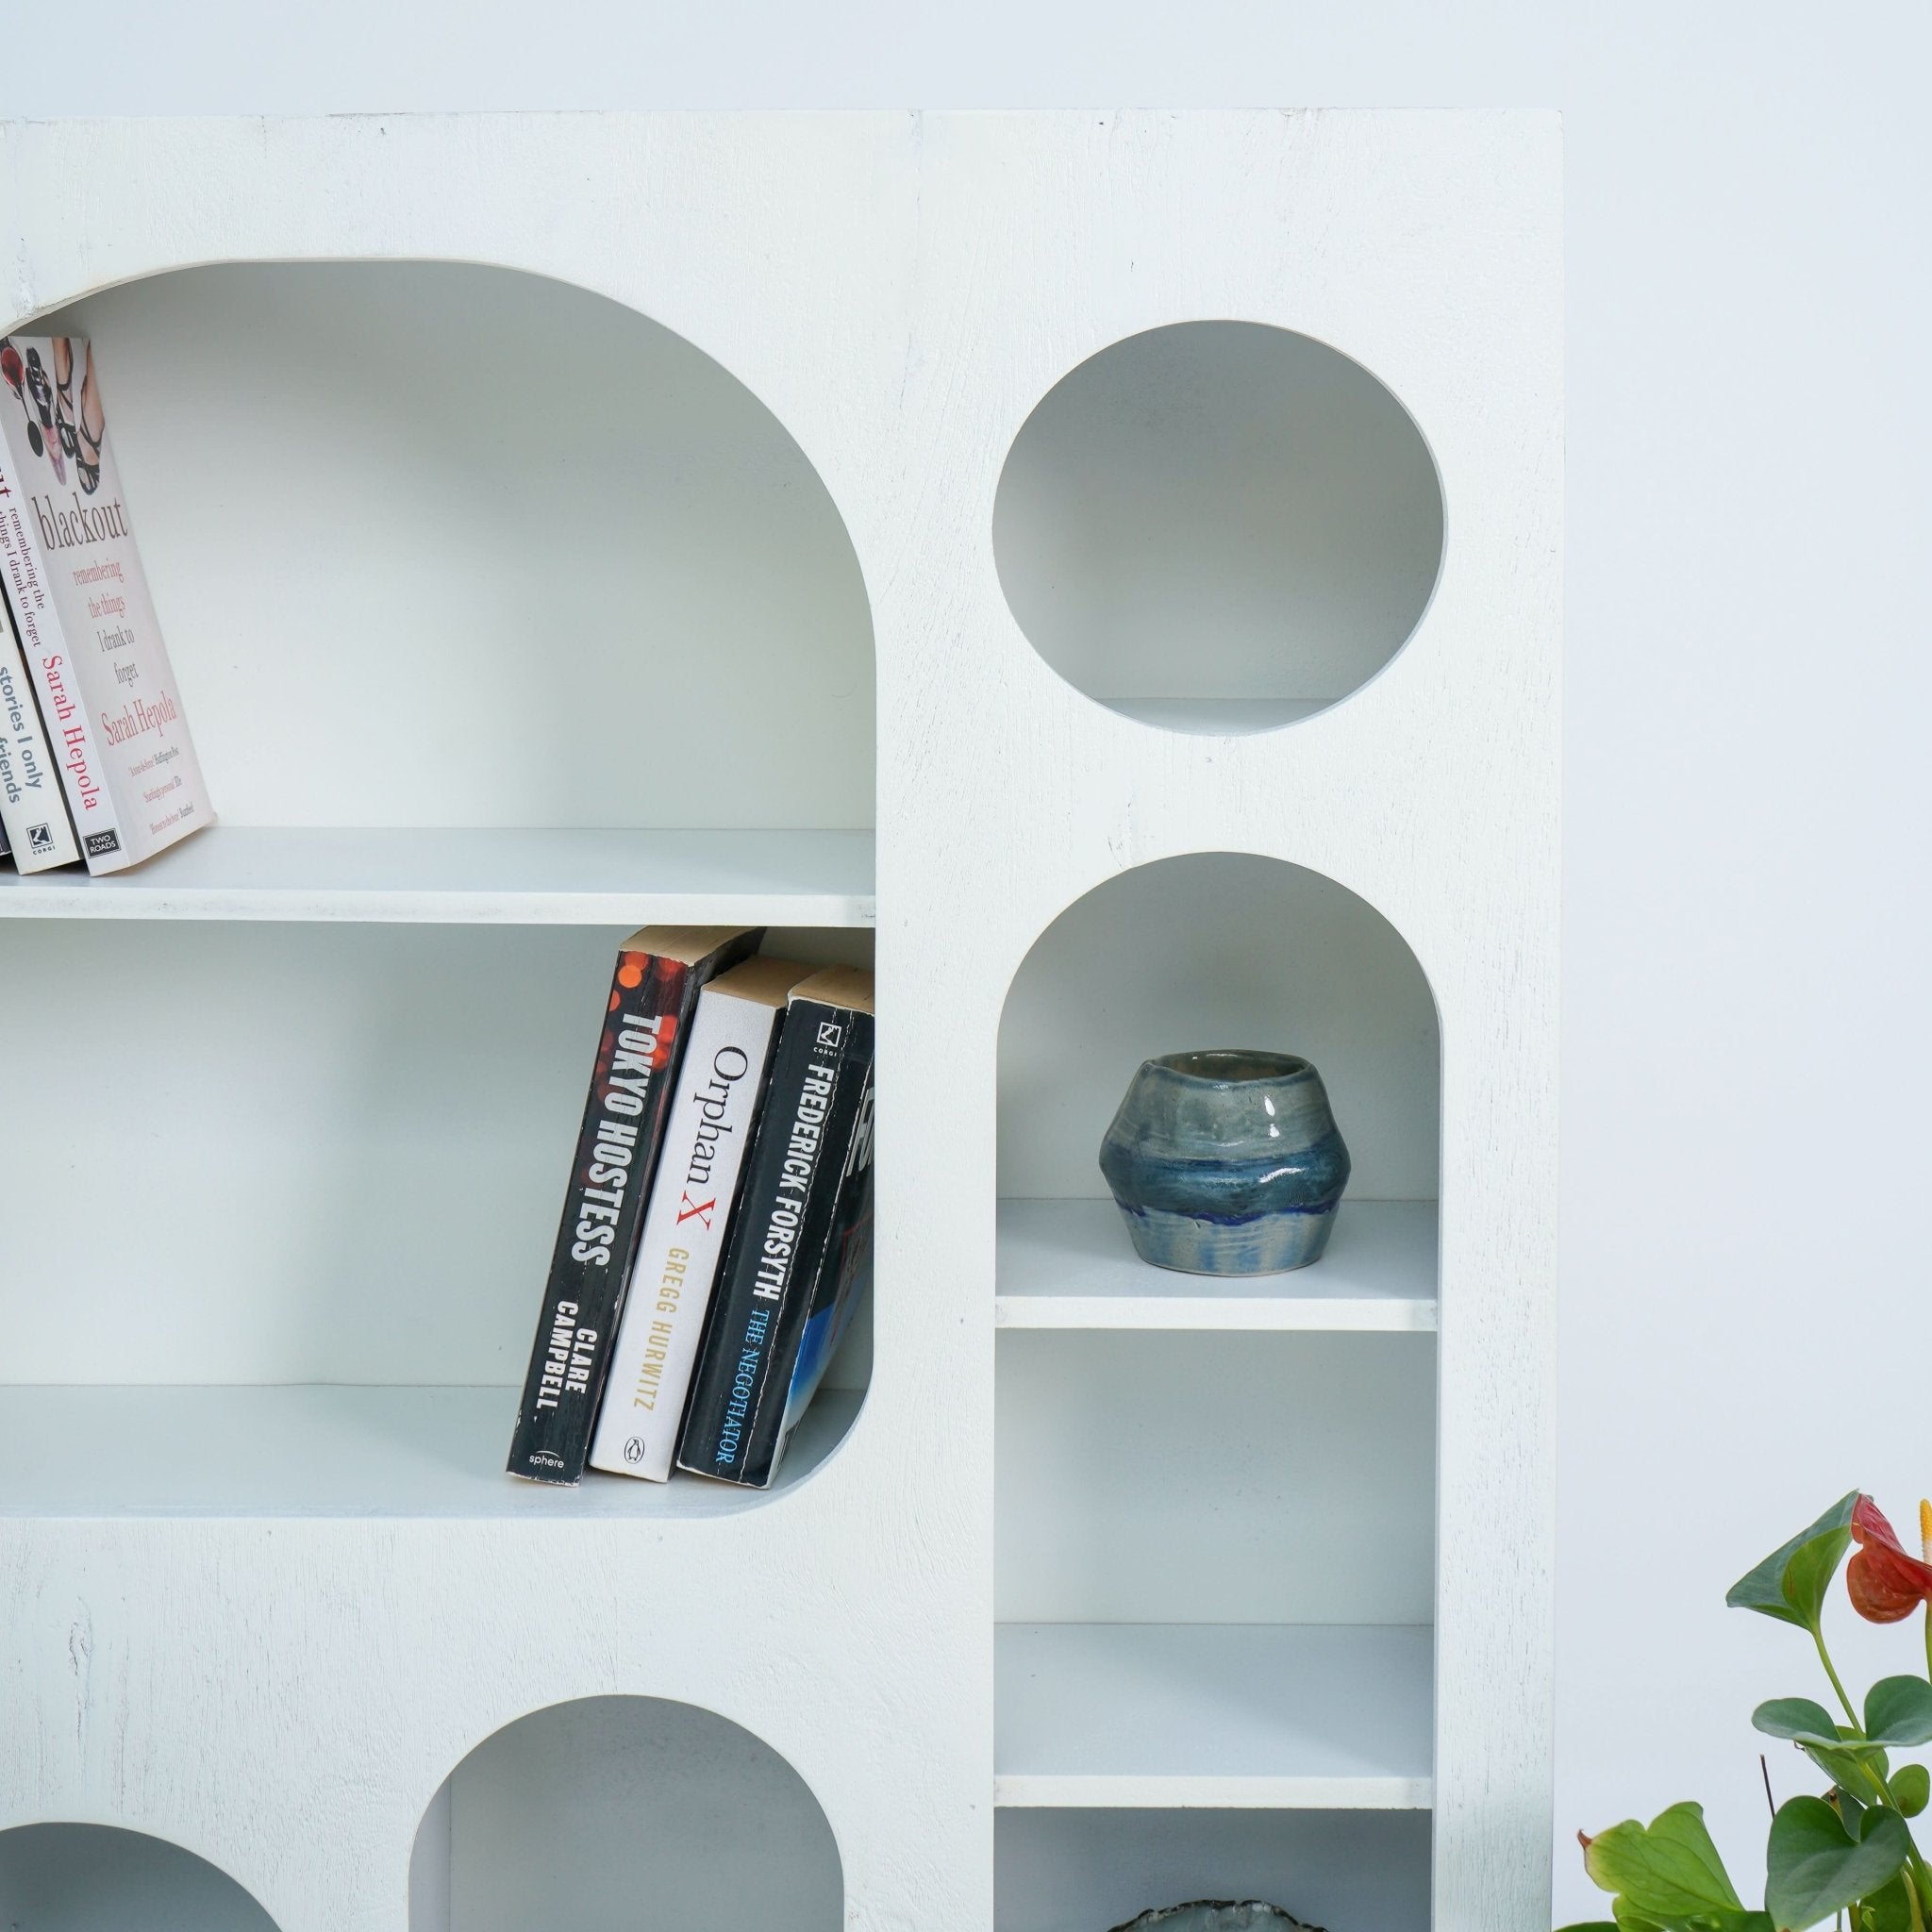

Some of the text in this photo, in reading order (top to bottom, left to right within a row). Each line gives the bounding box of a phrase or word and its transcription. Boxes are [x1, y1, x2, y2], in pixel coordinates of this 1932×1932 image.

[31, 491, 128, 551] blackout
[9, 508, 45, 609] remembering the
[73, 558, 125, 586] remembering
[9, 559, 27, 594] drank
[20, 596, 29, 608] to
[25, 611, 42, 647] forget
[88, 593, 125, 619] the things
[97, 625, 135, 652] I drank to
[114, 662, 139, 688] forget
[0, 666, 25, 732] stories
[22, 749, 43, 789] only
[42, 655, 100, 810] Sarah Hepola
[101, 691, 177, 746] Sarah Hepola
[32, 844, 56, 856] CORGI
[90, 840, 116, 854] ROADS
[91, 833, 111, 845] TWO
[812, 1046, 838, 1058] CORGI
[571, 1012, 662, 1267] TOKYO HOSTESS
[633, 1045, 748, 1412] Orphan X GREGG HURWITZ
[716, 1063, 836, 1464] FREDERICK FORSYTH THE NEGOTIATOR
[536, 1300, 579, 1409] CAMPBELL
[565, 1327, 598, 1395] CLARE
[528, 1456, 565, 1470] sphere
